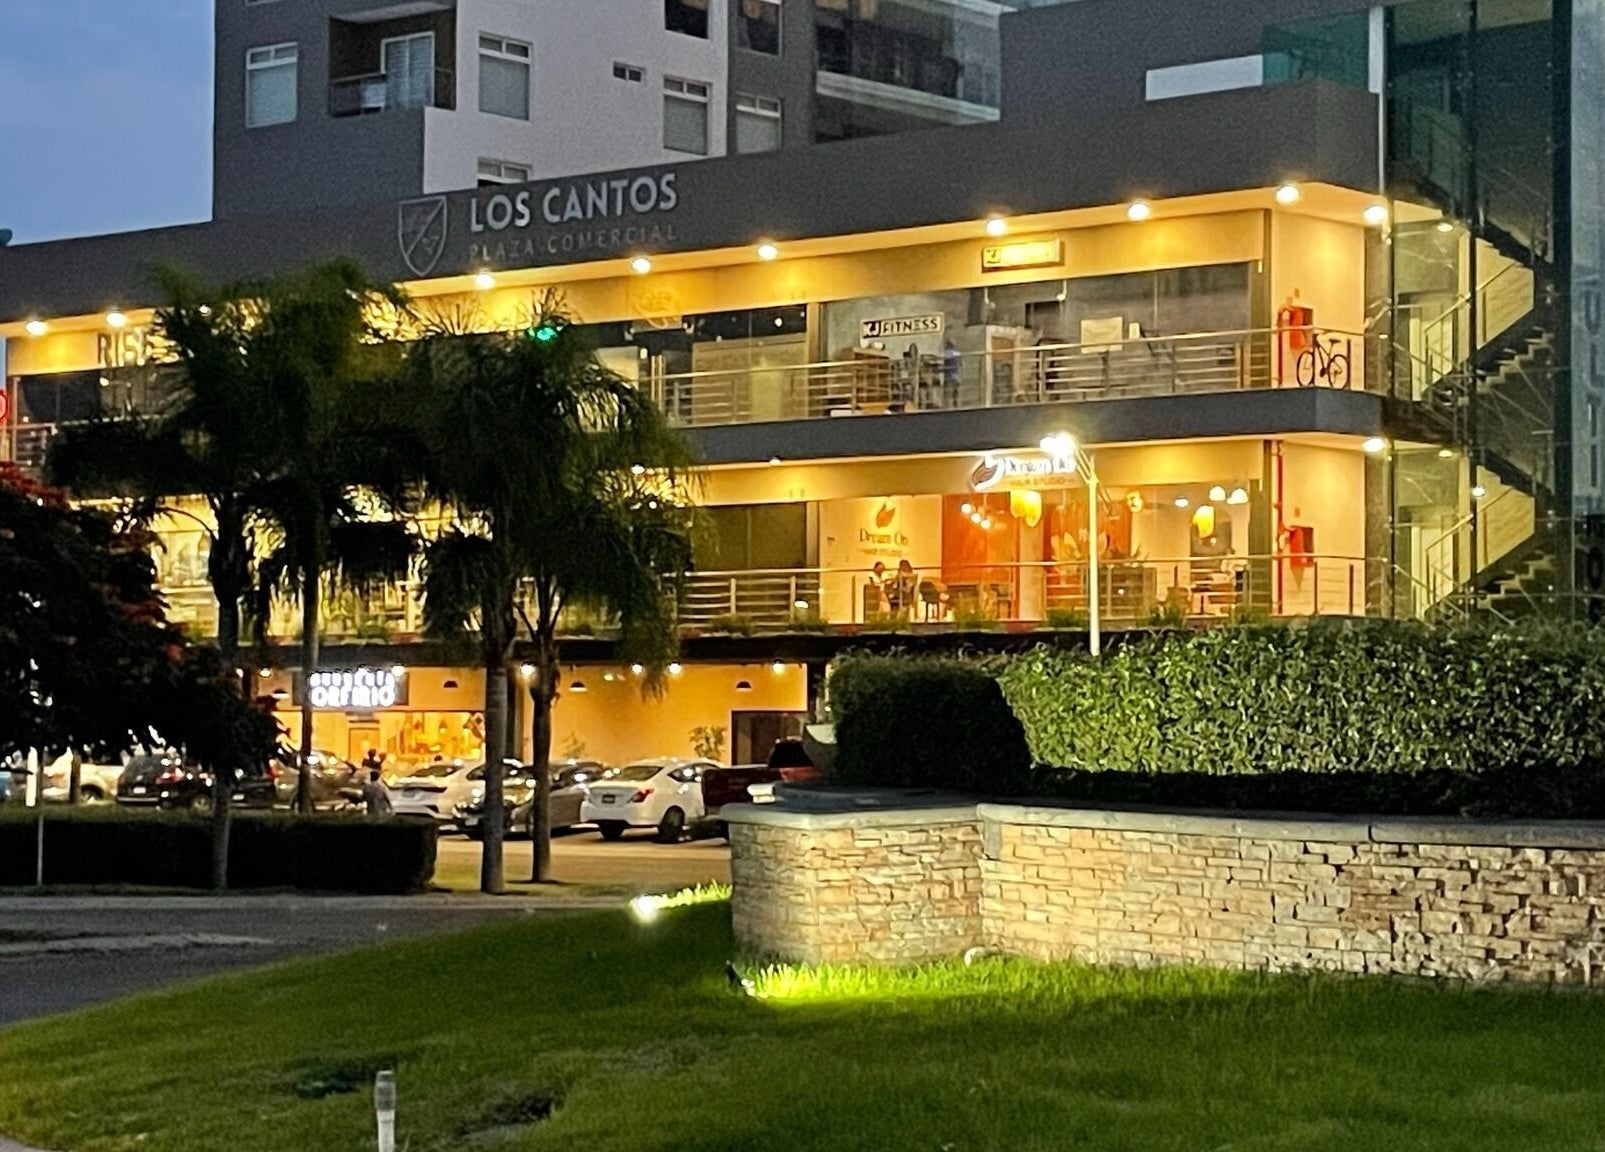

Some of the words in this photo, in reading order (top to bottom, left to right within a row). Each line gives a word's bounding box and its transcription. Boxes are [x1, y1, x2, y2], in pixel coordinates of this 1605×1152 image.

[470, 190, 531, 233] LOS
[542, 172, 678, 224] CANTOS
[469, 238, 535, 263] PLAZA
[547, 223, 677, 254] COMERCIAL
[883, 317, 938, 334] FITNESS
